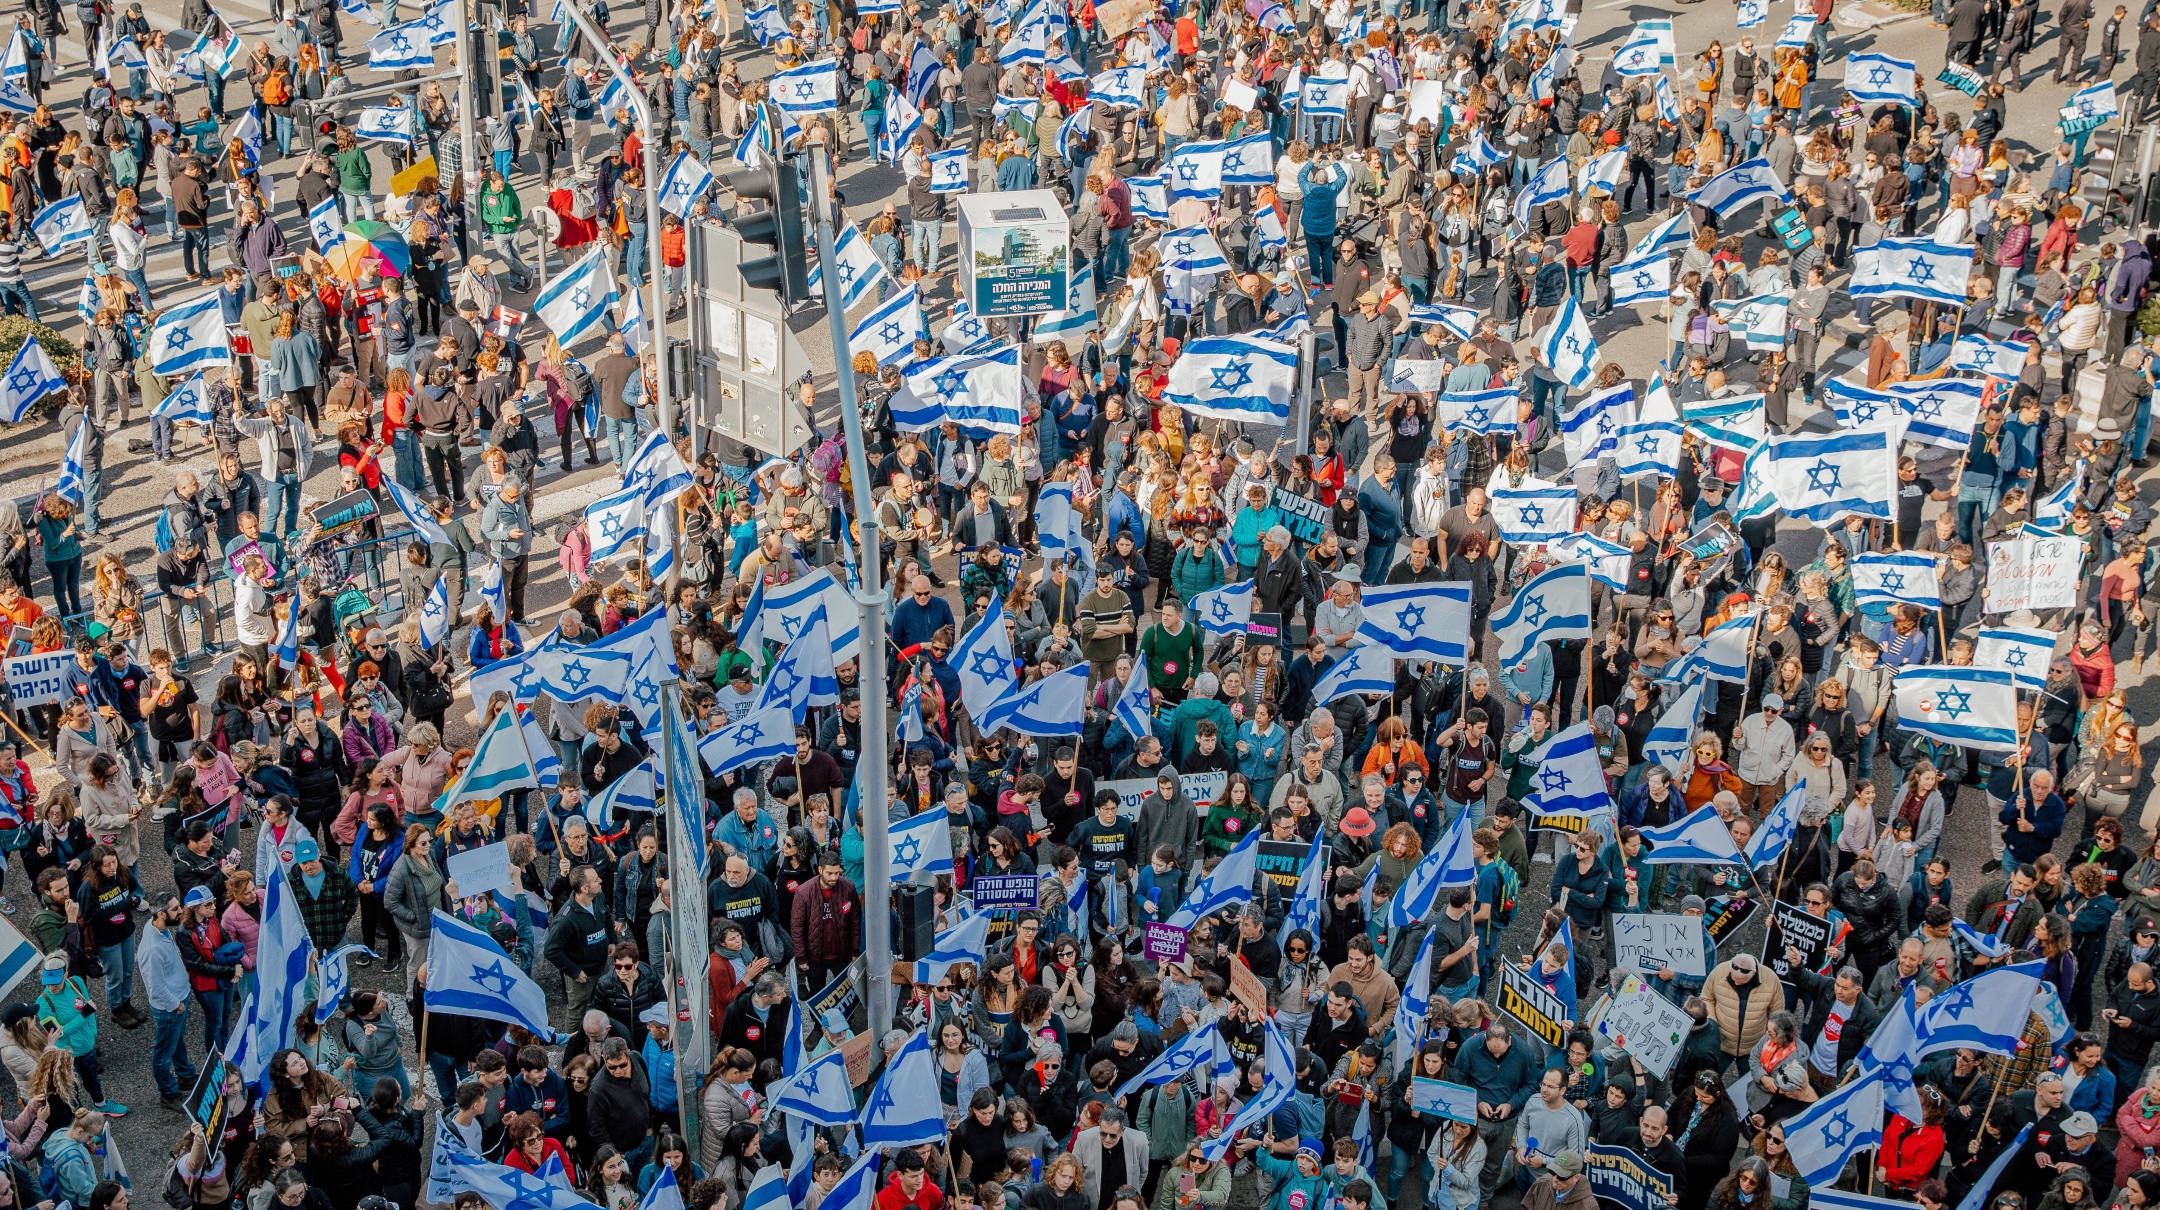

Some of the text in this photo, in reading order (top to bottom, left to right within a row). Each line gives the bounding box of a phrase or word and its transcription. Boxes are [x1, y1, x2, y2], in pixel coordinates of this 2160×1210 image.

[1948, 61, 1985, 87] חופשי
[1009, 268, 1016, 278] 5
[992, 280, 1050, 294] המכירה החלה
[322, 499, 374, 530] אין חינוך
[1276, 488, 1328, 524] חופשי
[2030, 540, 2066, 560] ישראל
[12, 654, 76, 676] דרושה
[1194, 772, 1224, 784] הרופא
[977, 888, 1034, 900] מדיקטטורה
[978, 879, 1034, 890] הנפש חולה
[1637, 916, 1688, 946] אין לי
[1778, 910, 1826, 940] ממשלת
[1620, 944, 1696, 963] ארץ אחרת
[1504, 962, 1562, 1026] חובה
[1638, 993, 1654, 1015] לי
[1504, 984, 1562, 1046] להתנגד
[1658, 1009, 1683, 1029] יש
[1615, 1012, 1667, 1063] חלום
[1591, 1153, 1667, 1196] בלי דמוקרטיה
[1592, 1168, 1643, 1204] אקדמיה
